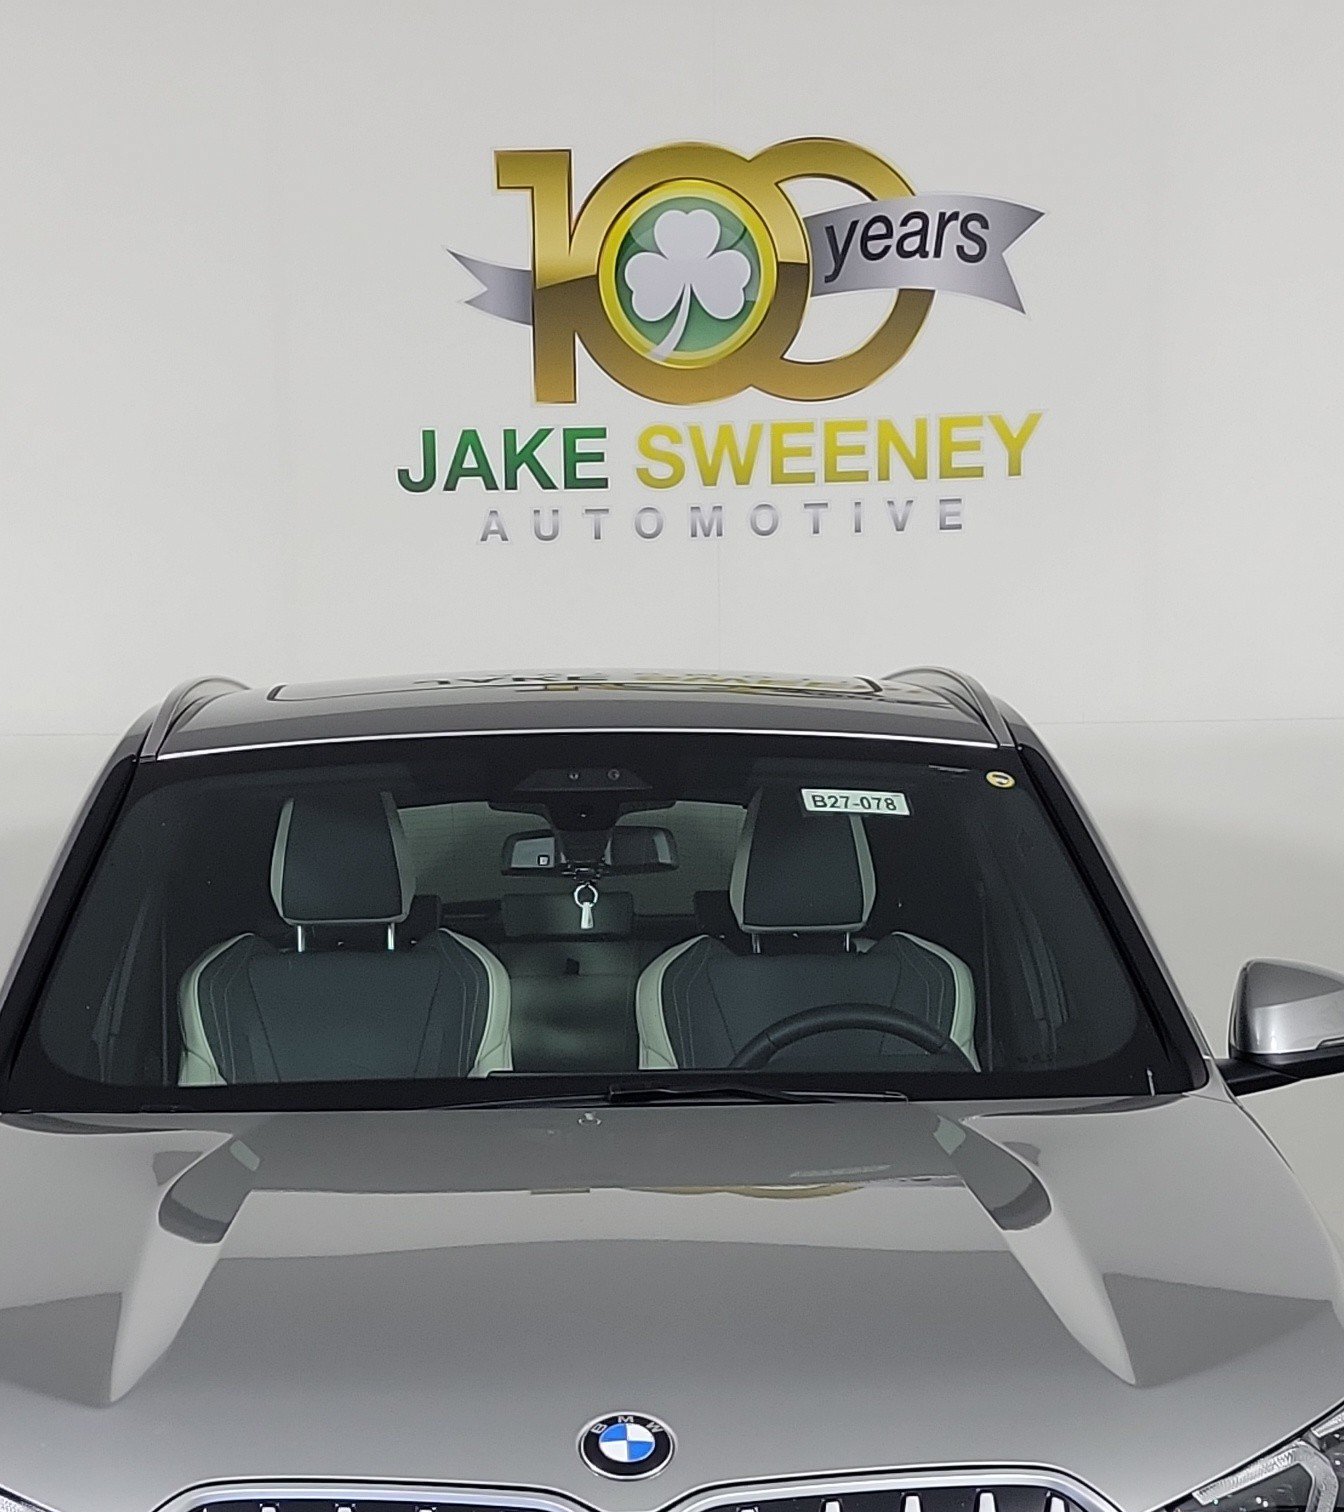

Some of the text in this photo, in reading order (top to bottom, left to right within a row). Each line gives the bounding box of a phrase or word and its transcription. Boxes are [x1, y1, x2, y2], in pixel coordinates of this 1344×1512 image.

[823, 207, 991, 283] years
[397, 412, 1042, 493] JAKE SWEENEY
[479, 498, 963, 543] AUTOMOTIVE
[811, 794, 897, 811] B27-078
